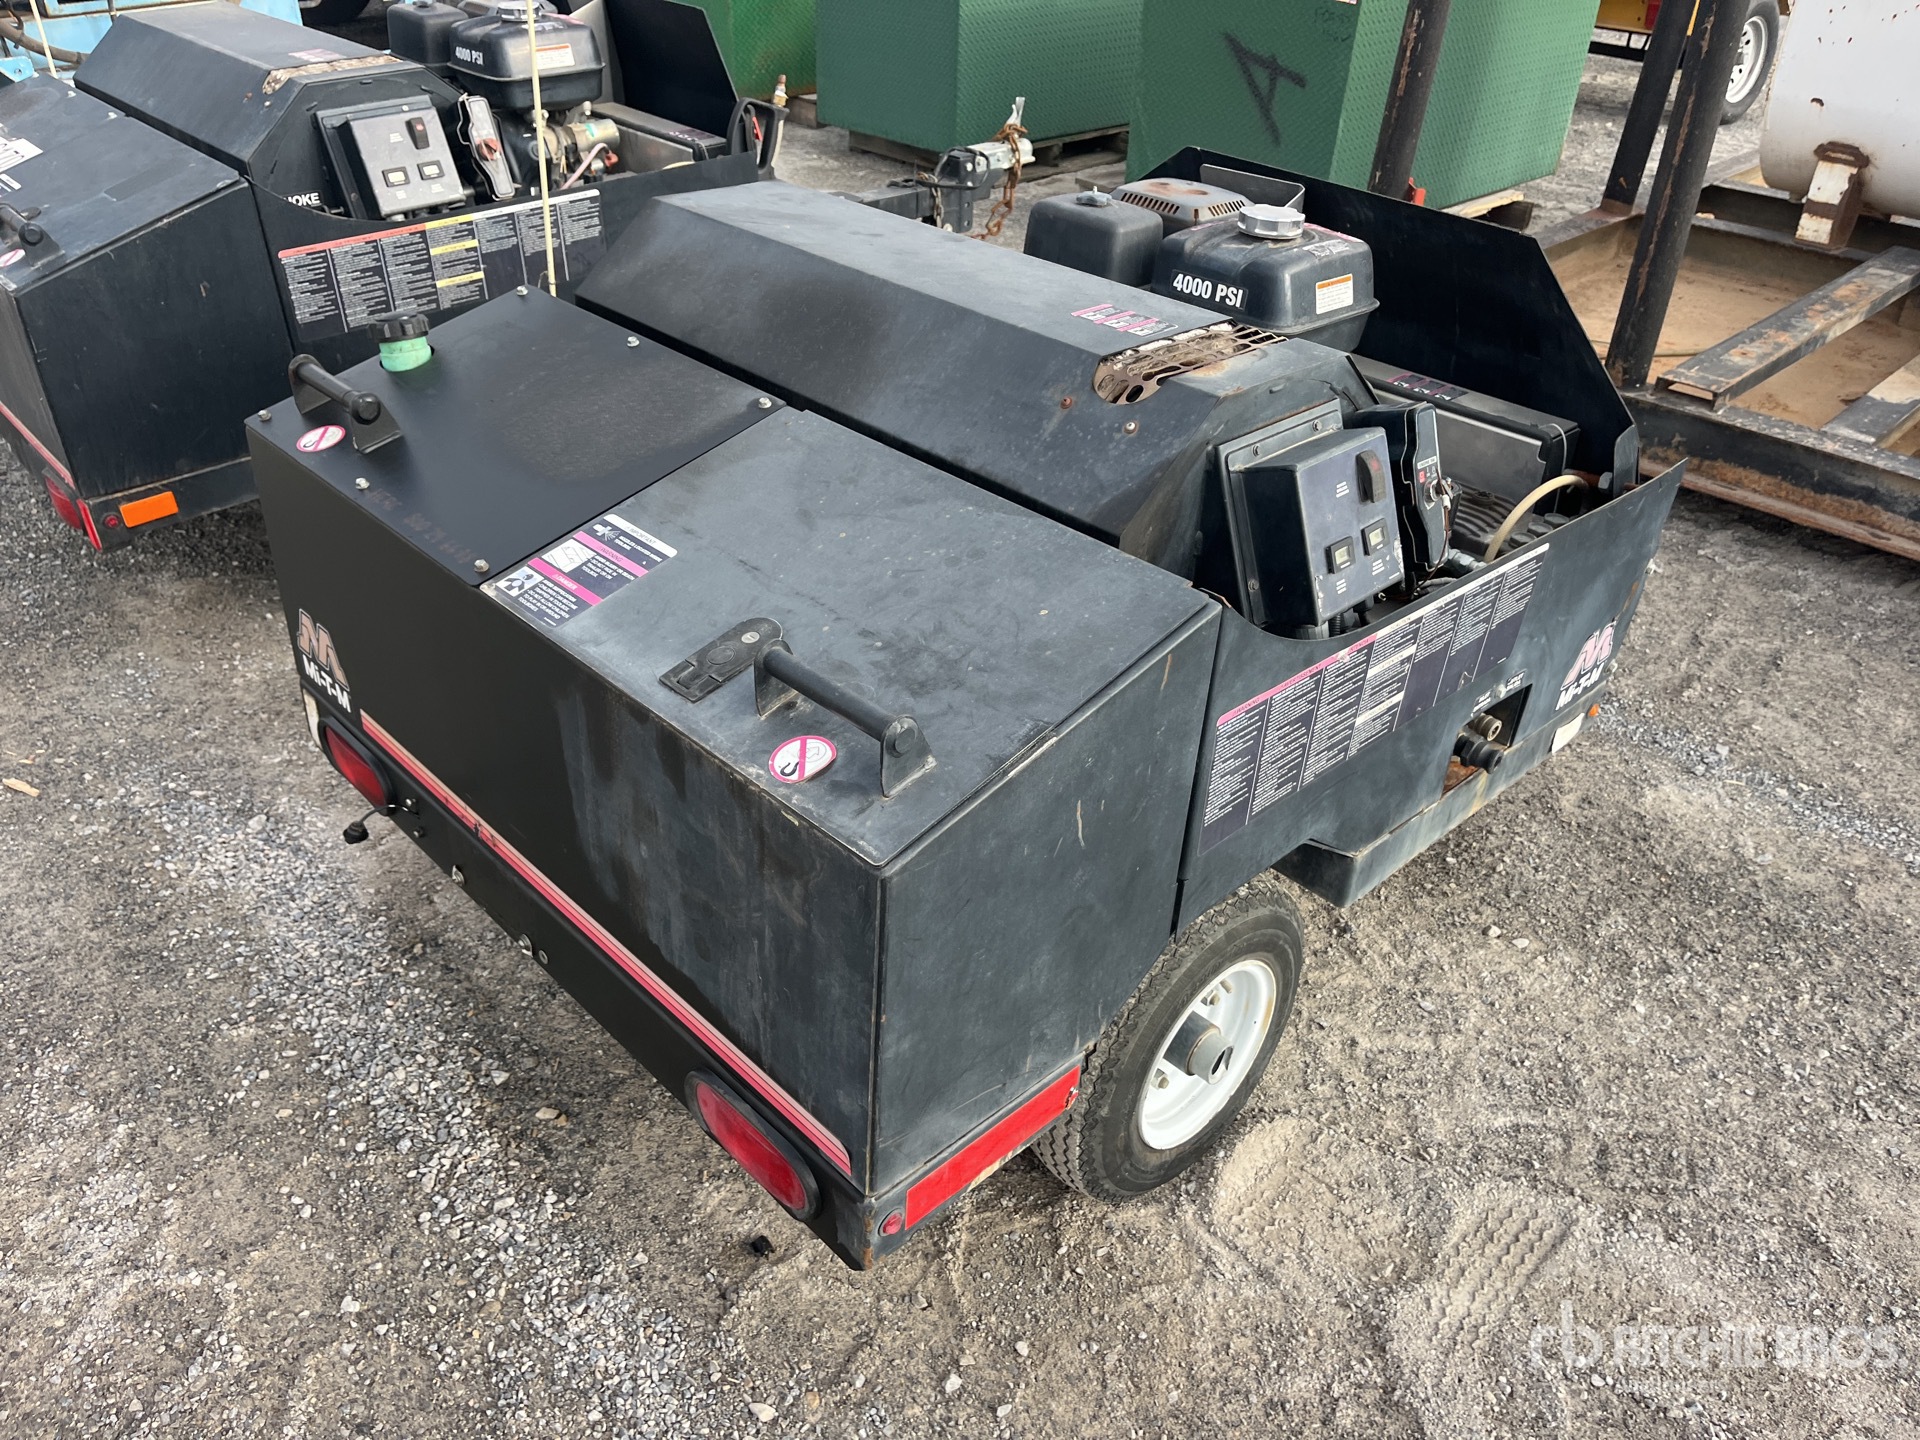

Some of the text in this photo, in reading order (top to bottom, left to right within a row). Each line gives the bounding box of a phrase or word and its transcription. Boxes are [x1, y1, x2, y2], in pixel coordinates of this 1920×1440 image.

[456, 46, 484, 65] 4000 PSI
[1172, 273, 1244, 308] 4000 PSI
[600, 546, 623, 562] WARNING
[556, 575, 577, 590] DANGER
[302, 653, 352, 713] Mi-T-M
[1555, 662, 1605, 711] Mi-T-M
